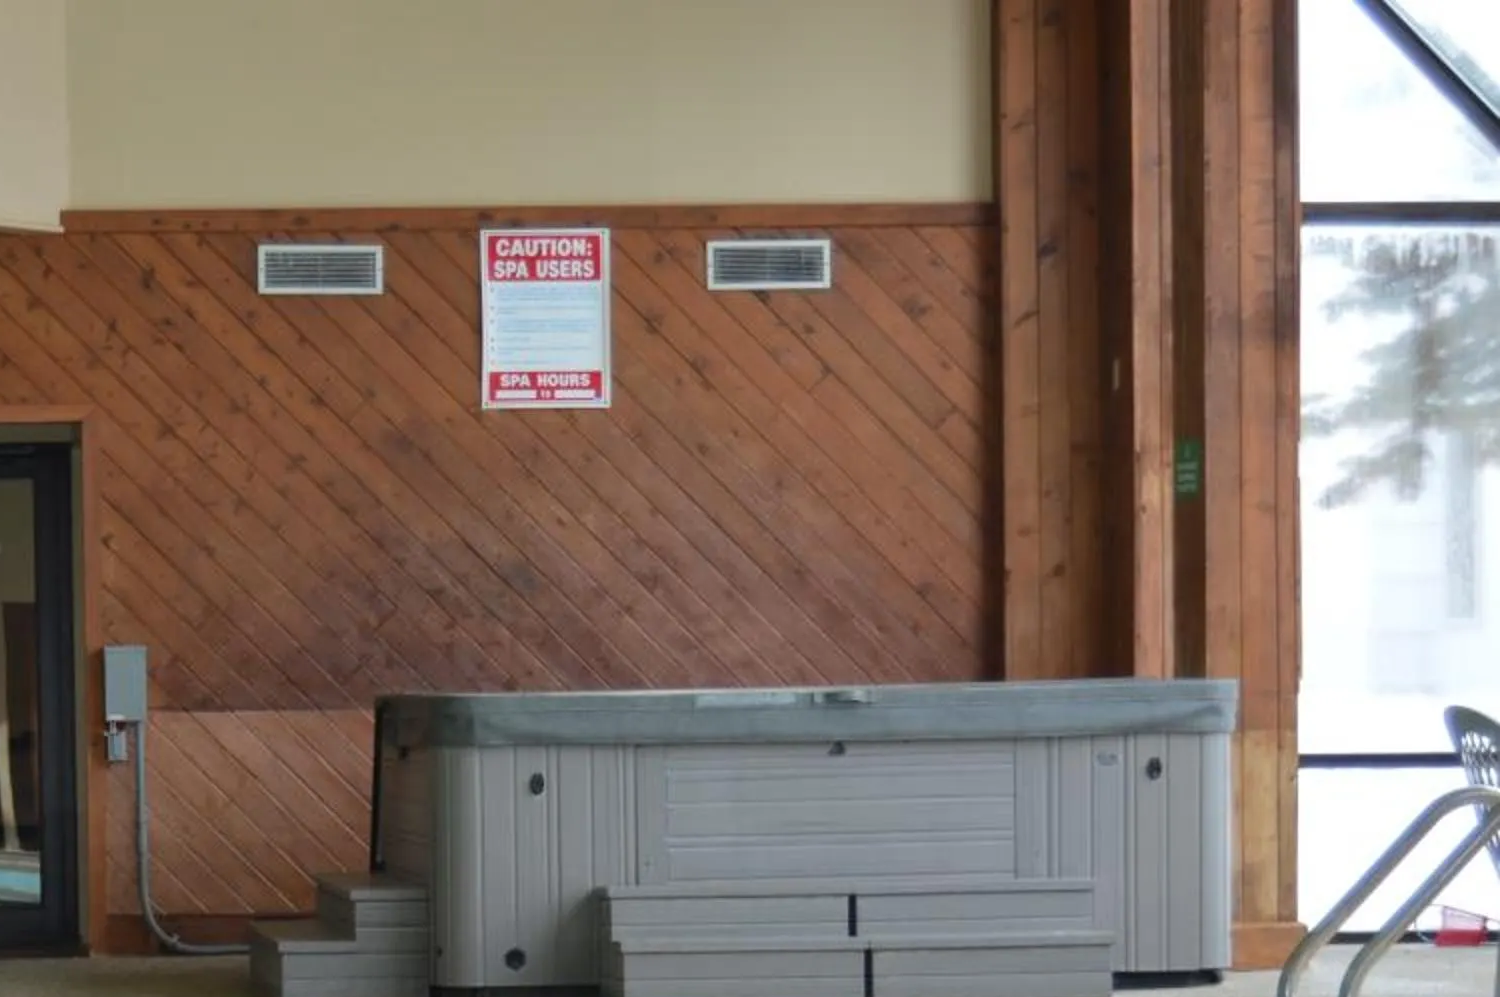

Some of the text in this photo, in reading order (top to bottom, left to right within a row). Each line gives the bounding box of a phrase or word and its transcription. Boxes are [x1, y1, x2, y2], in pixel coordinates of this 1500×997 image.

[495, 238, 593, 257] CAUTION:
[494, 260, 595, 278] SPA USERS
[501, 374, 591, 387] SPA HOURS
